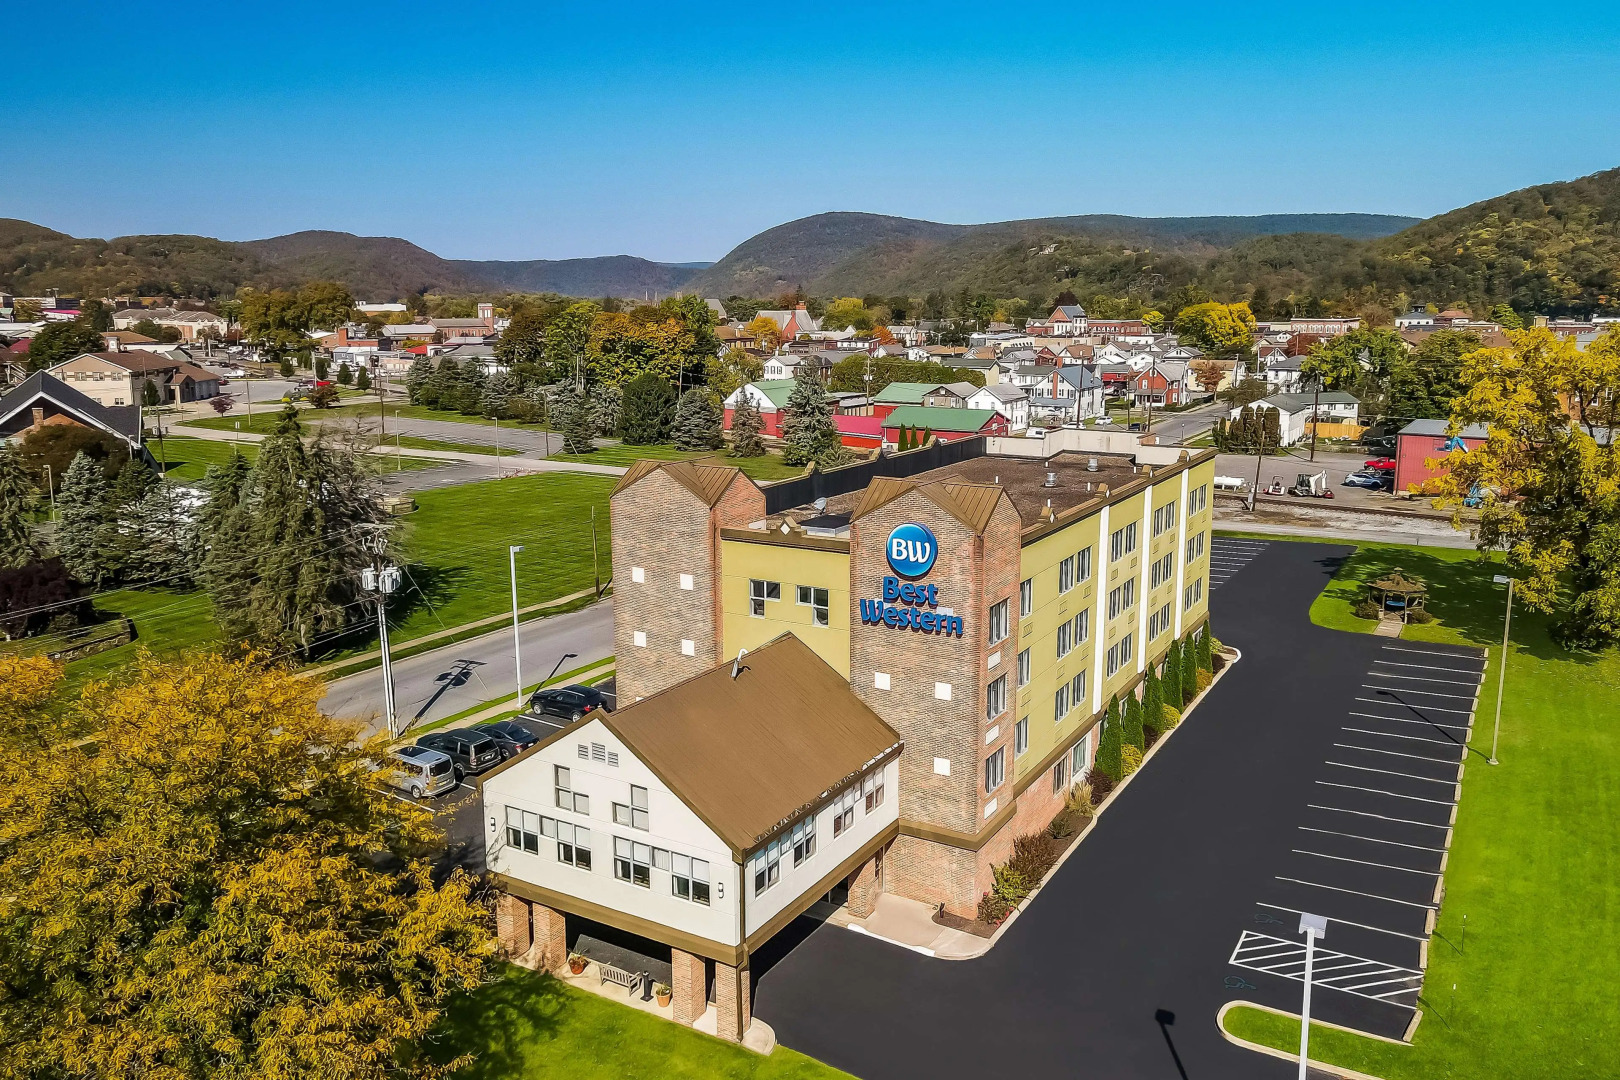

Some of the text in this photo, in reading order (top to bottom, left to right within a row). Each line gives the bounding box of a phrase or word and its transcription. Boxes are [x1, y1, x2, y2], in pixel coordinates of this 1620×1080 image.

[892, 538, 931, 563] BW
[883, 576, 939, 606] Best
[860, 599, 963, 636] Western
